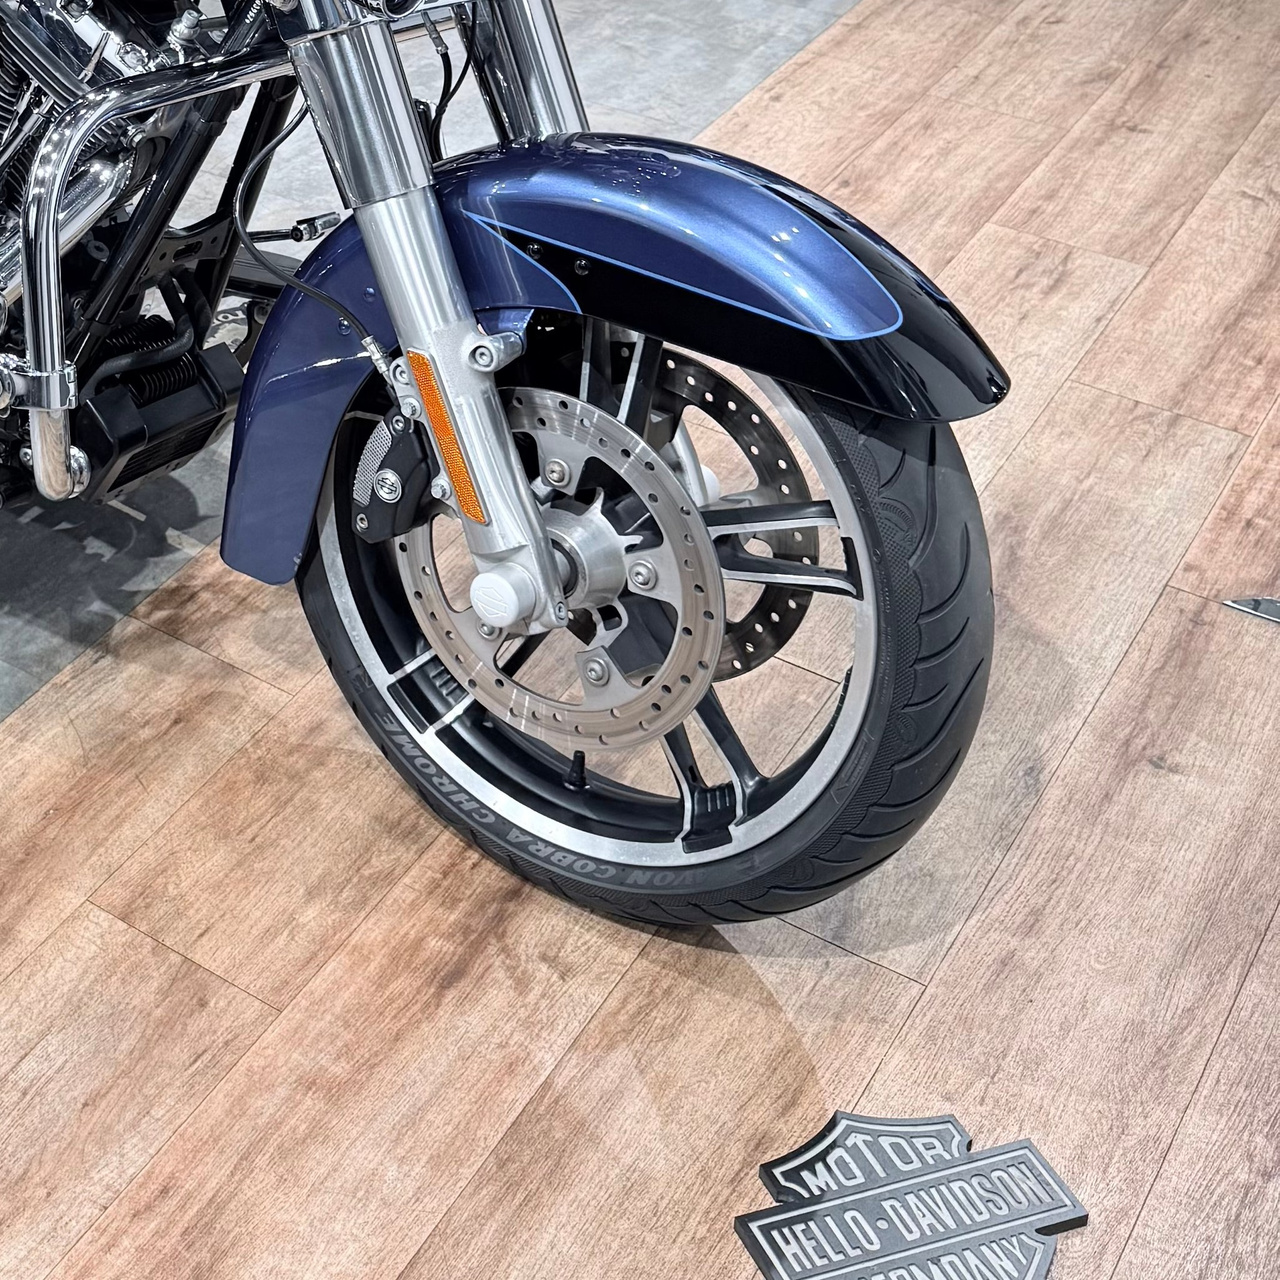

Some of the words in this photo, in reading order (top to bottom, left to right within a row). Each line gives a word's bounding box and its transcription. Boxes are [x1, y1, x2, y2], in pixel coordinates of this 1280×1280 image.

[375, 711, 497, 825] CHROME
[503, 827, 617, 880] COBRA
[625, 868, 707, 887] AVON
[799, 1132, 953, 1197] MOTOR
[770, 1208, 881, 1273] HELLO
[880, 1161, 1054, 1243] DAVIDSON
